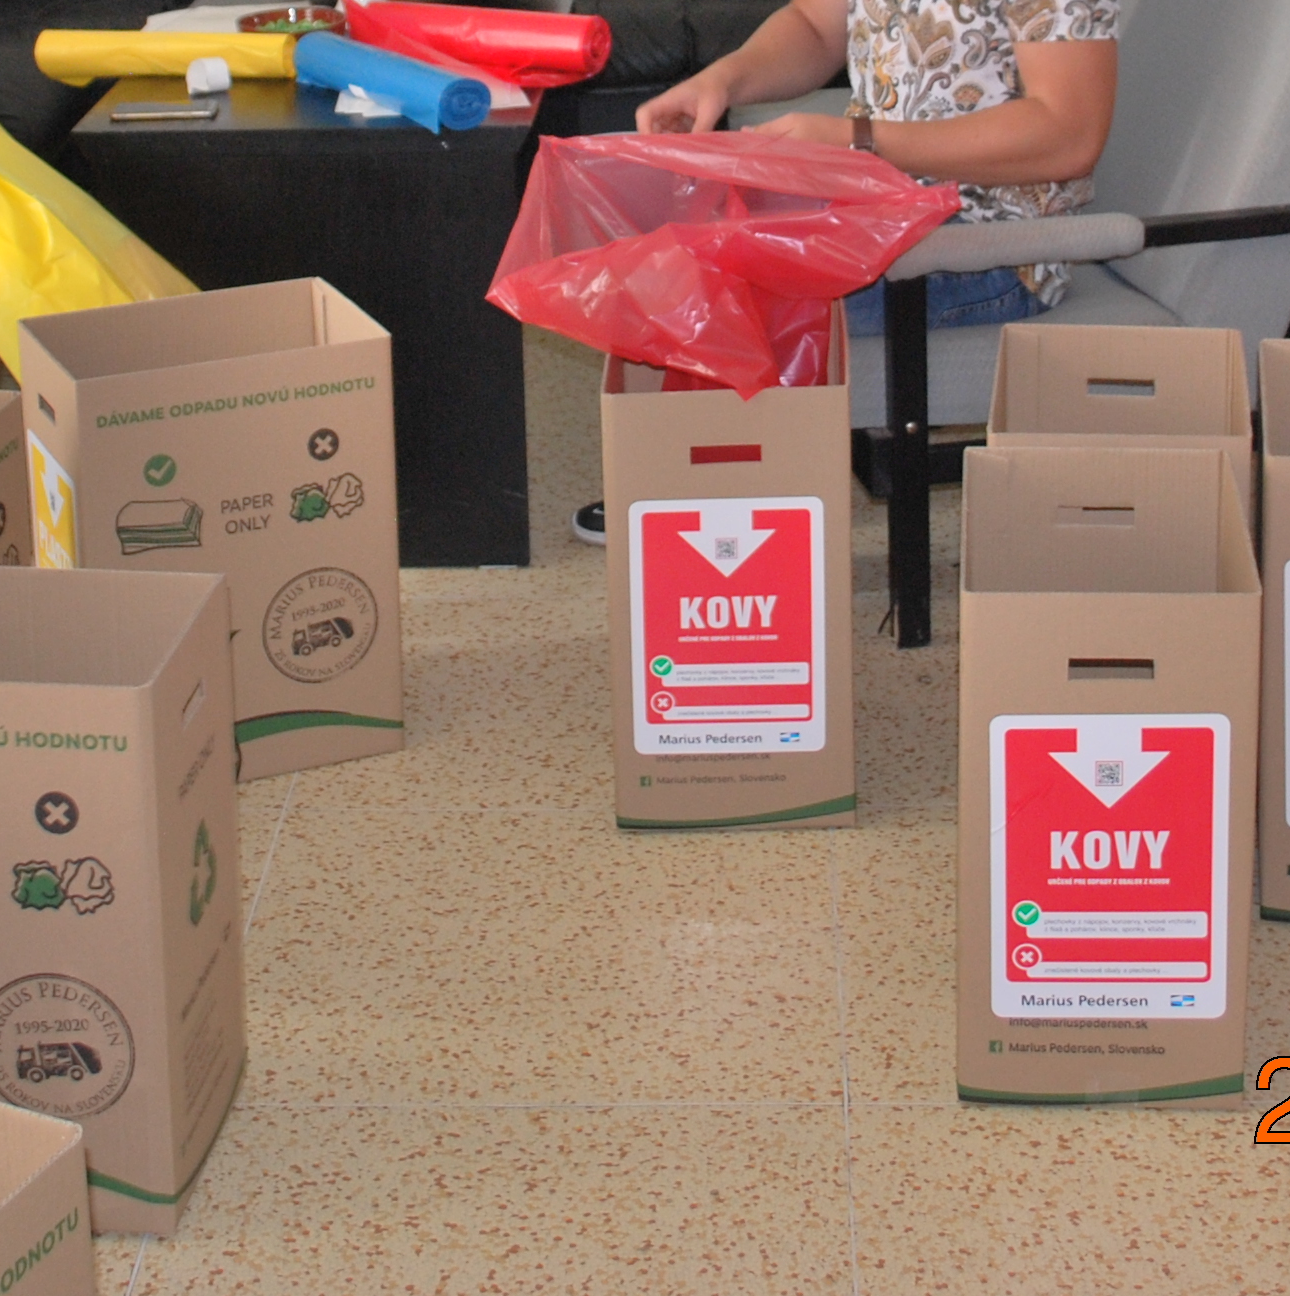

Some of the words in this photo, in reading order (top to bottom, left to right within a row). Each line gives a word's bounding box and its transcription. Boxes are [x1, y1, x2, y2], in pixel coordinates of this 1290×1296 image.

[96, 406, 164, 428] DÁVAME
[170, 398, 237, 419] ODPADU
[243, 387, 289, 407] NOVÚ
[294, 377, 376, 399] HODNOTU
[220, 493, 274, 514] PAPER
[225, 514, 271, 534] ONLY
[270, 584, 304, 640] MARIUS
[308, 575, 371, 615] PEDERSEN
[678, 594, 778, 630] KOVY
[15, 730, 128, 752] HODNOTU
[658, 734, 702, 745] Marius
[705, 733, 762, 745] Pedersen
[656, 776, 687, 785] Marius
[1049, 830, 1170, 870] KOVY
[1021, 994, 1073, 1007] Marius
[1078, 994, 1149, 1007] Pedersen
[37, 981, 124, 1047] PEDERSEN
[1009, 1017, 1148, 1030] info@mariuspedersen.sk
[14, 1018, 90, 1035] 1995-2020
[1009, 1042, 1047, 1053] Marius
[1049, 1042, 1105, 1055] Pedersen,
[1108, 1043, 1166, 1055] Slovensko
[5, 1082, 50, 1111] ROKOV
[54, 1104, 74, 1114] NA
